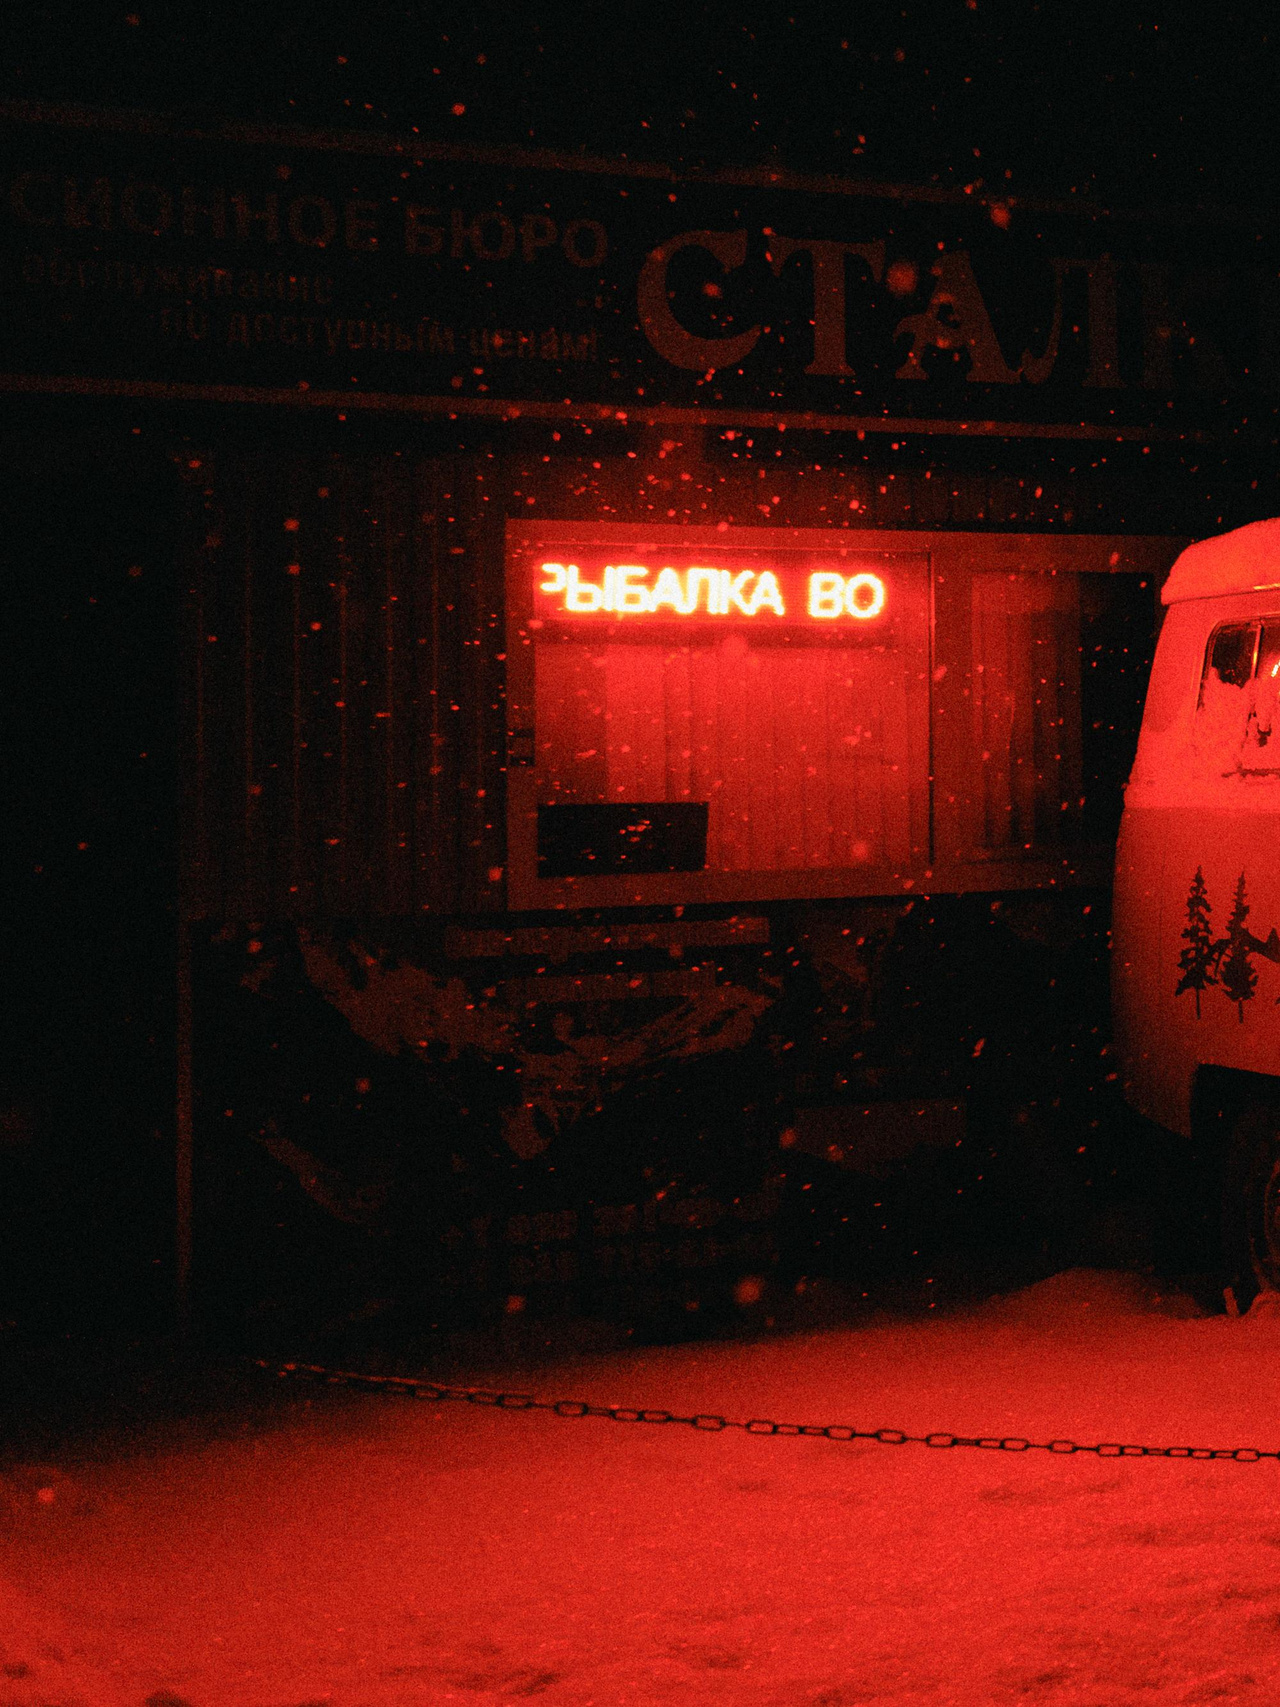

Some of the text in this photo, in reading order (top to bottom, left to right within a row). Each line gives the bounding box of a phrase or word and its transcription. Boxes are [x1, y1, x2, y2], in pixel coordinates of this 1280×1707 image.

[9, 170, 609, 269] СИОННОЕ БЮРО
[807, 571, 886, 618] ВО
